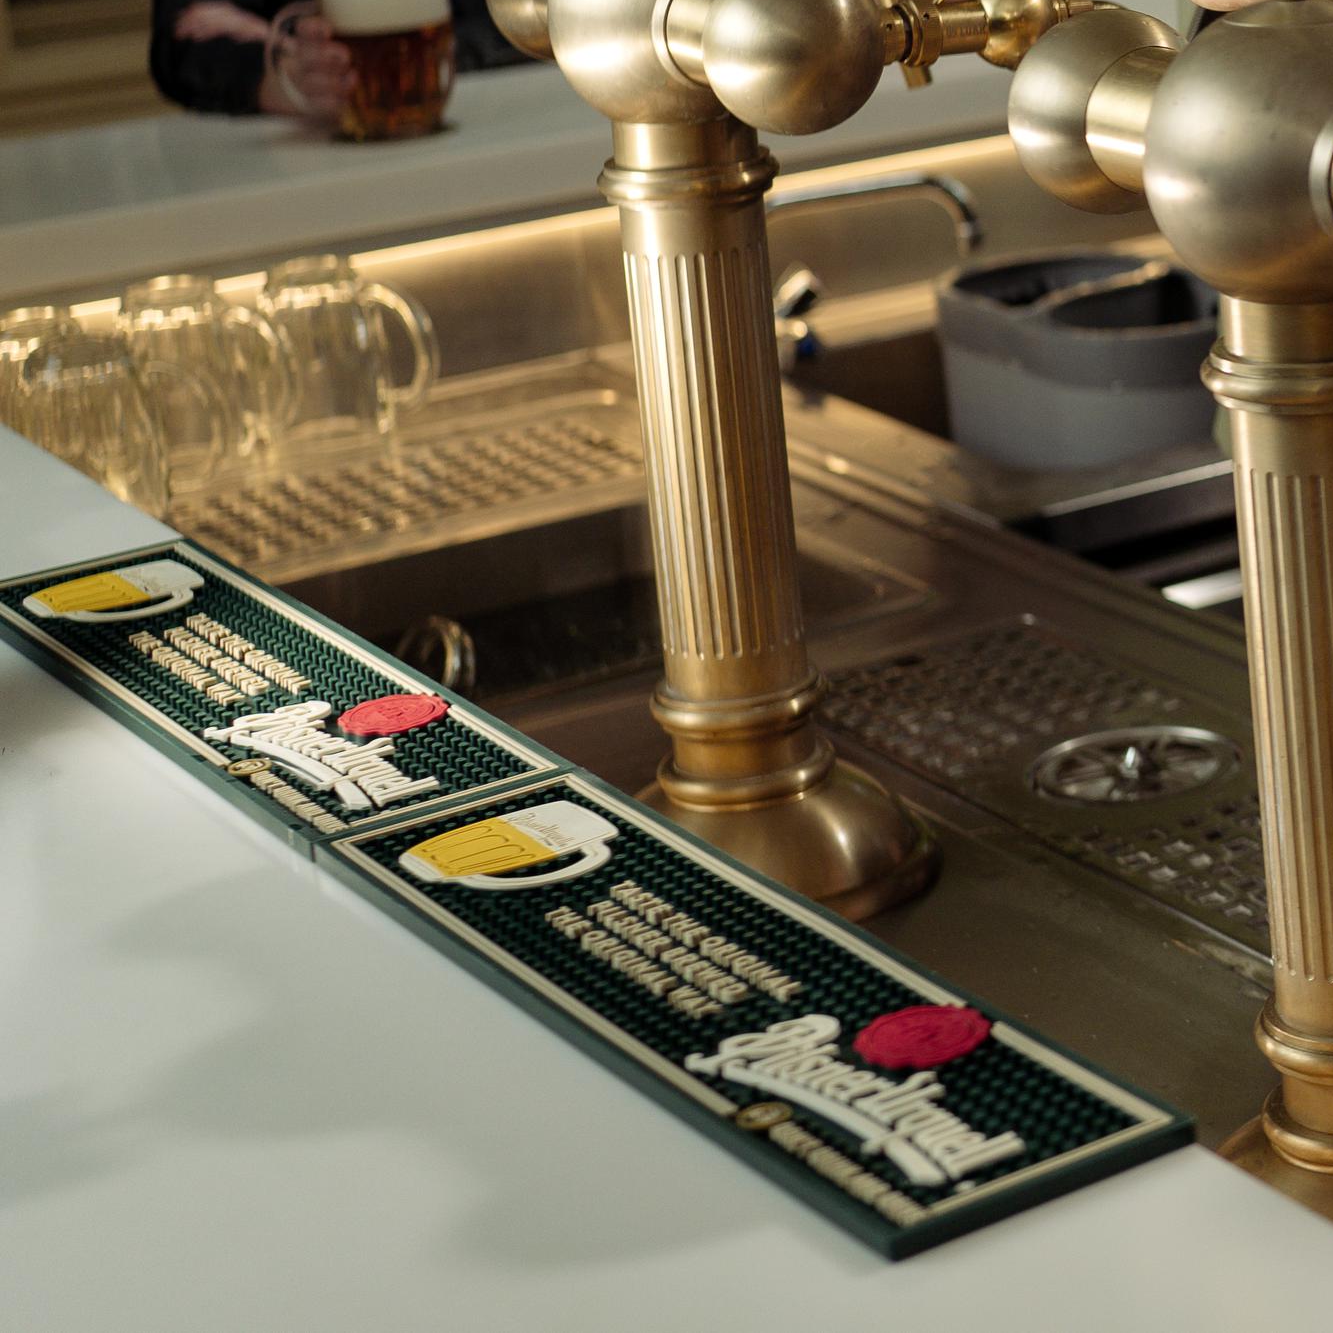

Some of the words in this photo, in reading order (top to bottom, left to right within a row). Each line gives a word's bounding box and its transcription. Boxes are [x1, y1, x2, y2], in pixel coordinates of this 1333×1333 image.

[545, 906, 592, 939] THE
[581, 930, 678, 997] ORIGINAL
[667, 985, 723, 1018] WAY
[587, 900, 672, 958] PILSNER
[660, 946, 748, 1004] BREWED
[610, 879, 674, 925] TASTE
[662, 912, 711, 948] THE
[700, 936, 801, 1003] ORIGINAL
